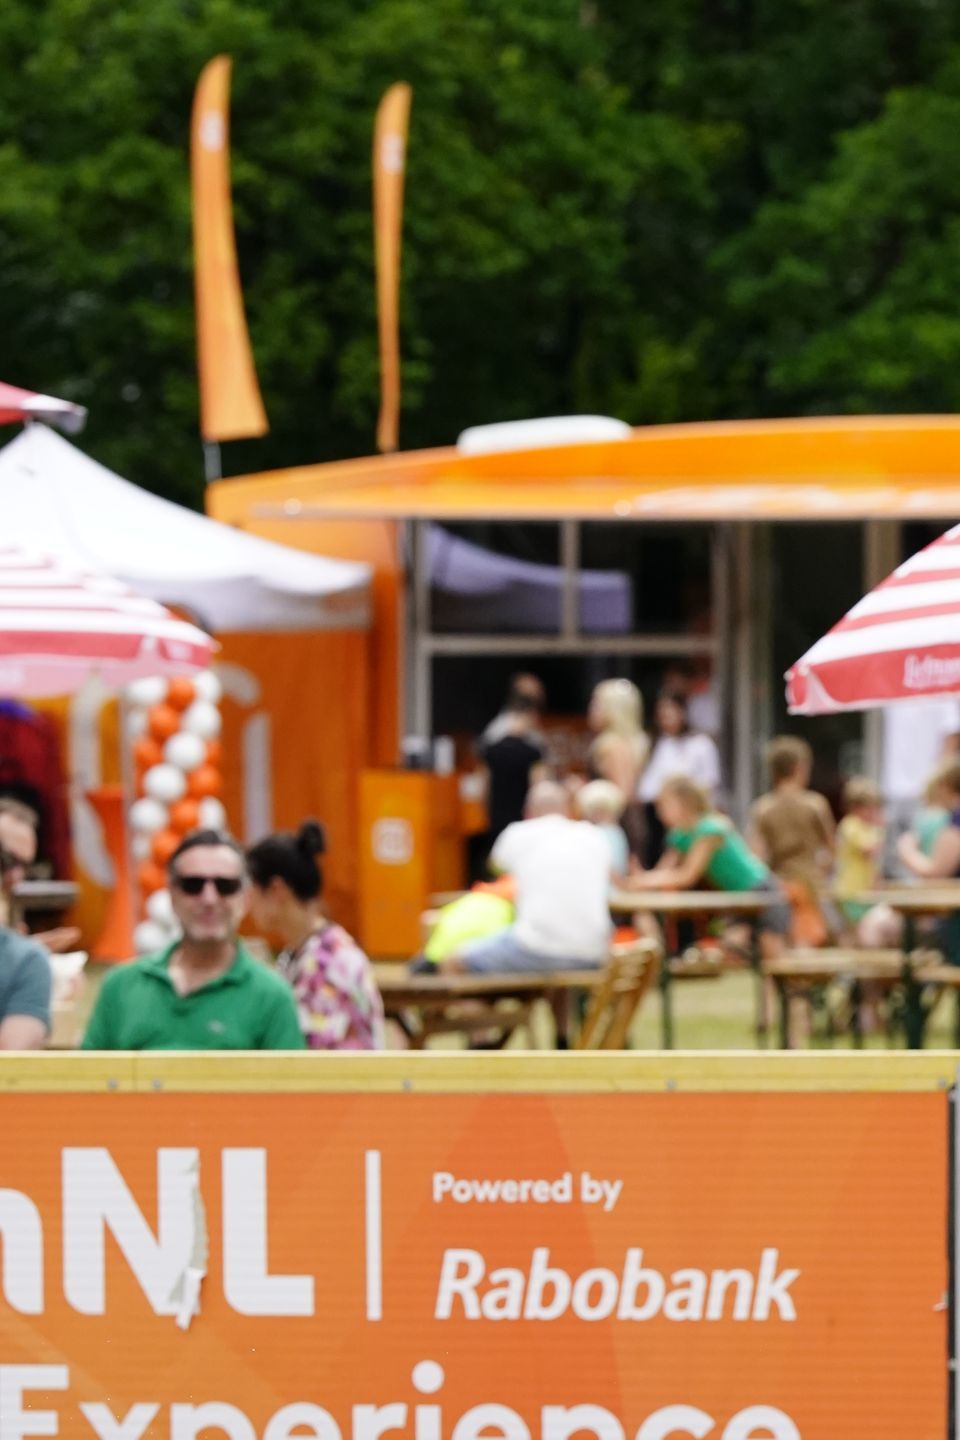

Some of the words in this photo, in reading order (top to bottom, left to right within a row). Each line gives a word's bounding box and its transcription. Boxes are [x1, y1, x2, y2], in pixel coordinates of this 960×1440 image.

[432, 1172, 573, 1203] Powered
[580, 1172, 623, 1212] by
[434, 1247, 801, 1321] Rabobank
